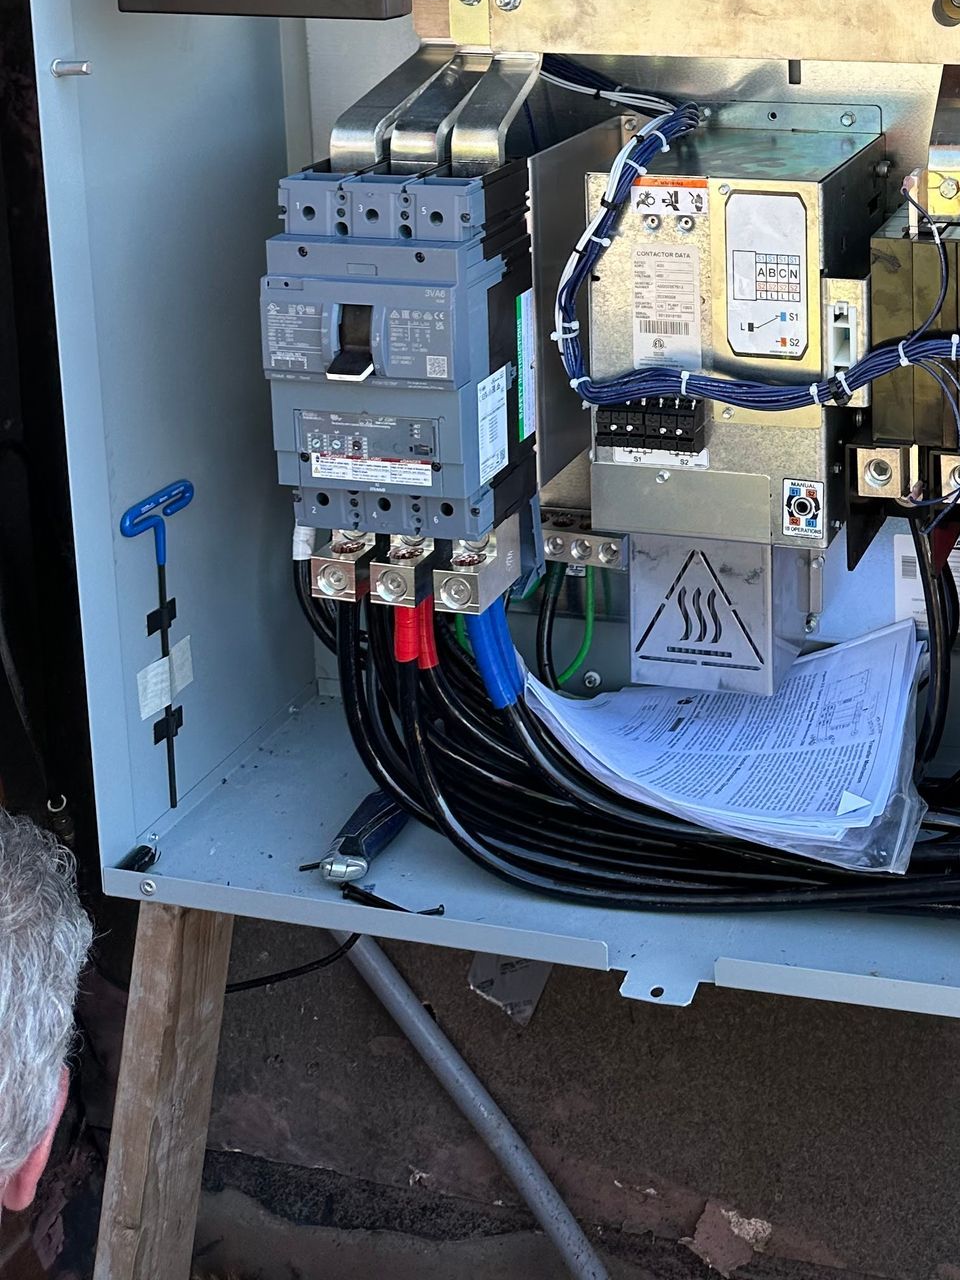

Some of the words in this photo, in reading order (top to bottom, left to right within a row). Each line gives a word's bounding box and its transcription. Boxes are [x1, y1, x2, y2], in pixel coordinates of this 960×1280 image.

[758, 268, 765, 277] A
[769, 268, 776, 277] B
[779, 269, 786, 278] C
[790, 270, 797, 279] N
[789, 313, 798, 321] S1
[741, 322, 745, 330] L
[790, 338, 800, 347] S2
[434, 516, 439, 524] 6
